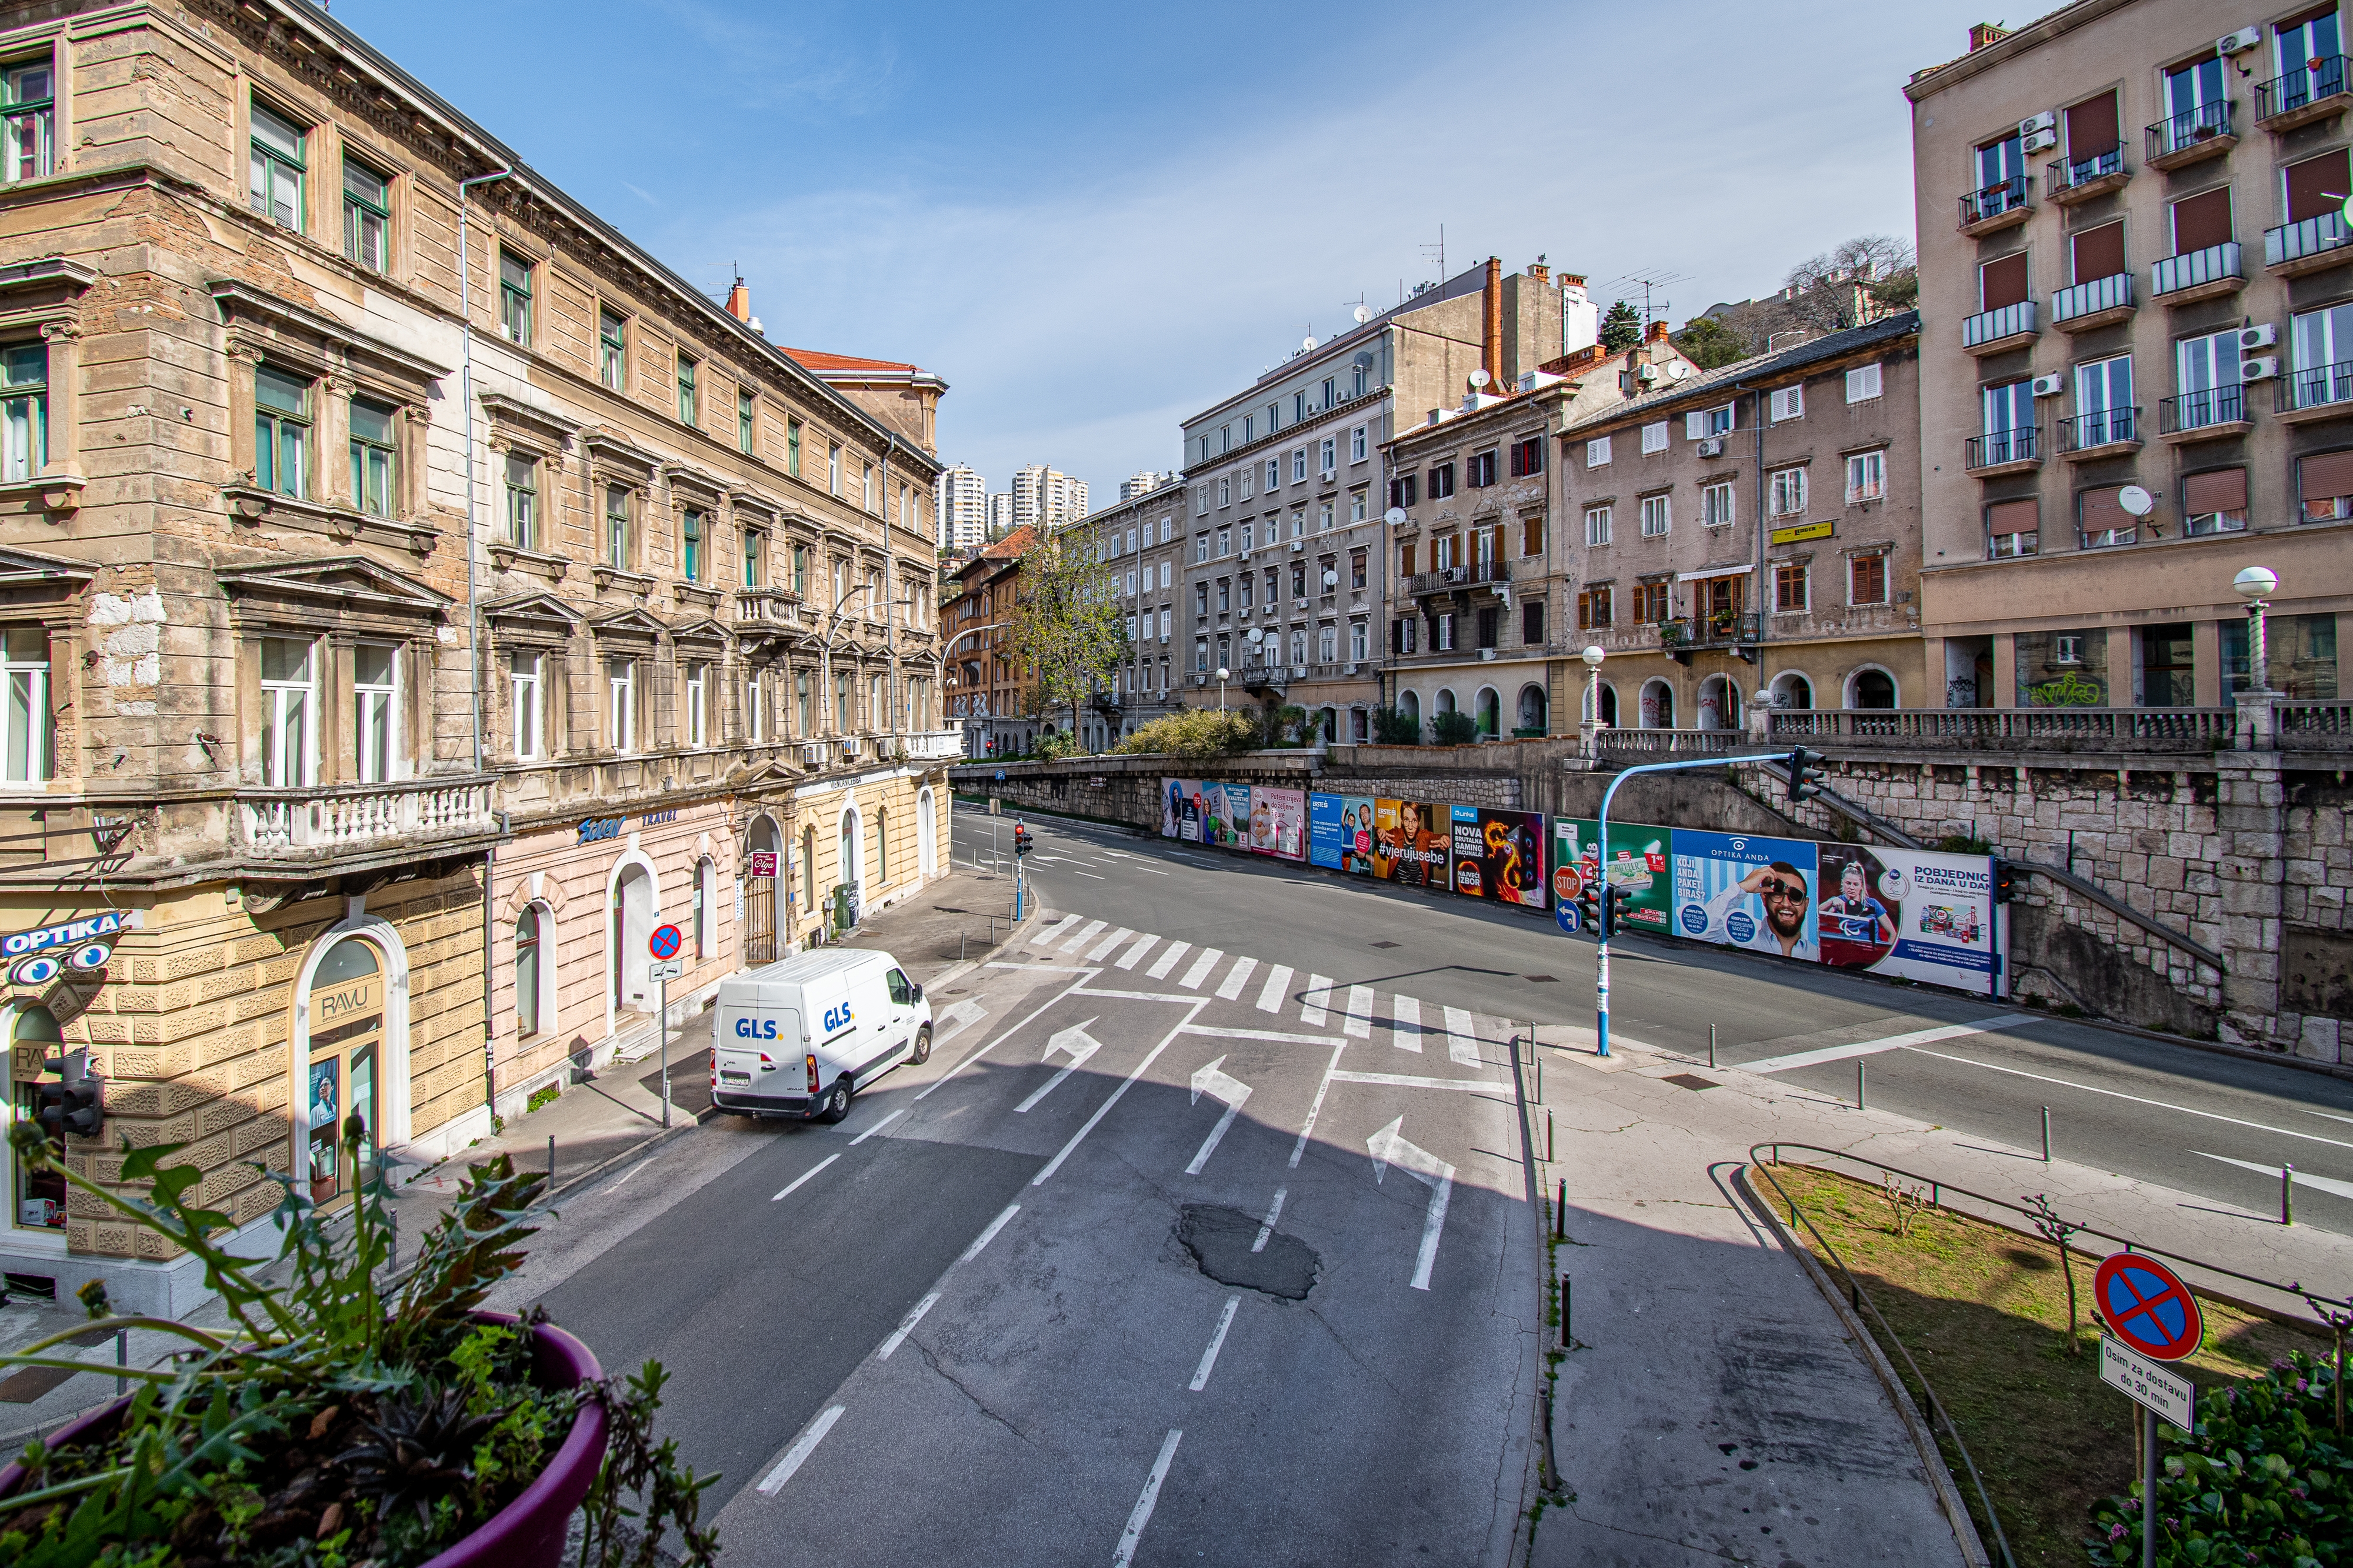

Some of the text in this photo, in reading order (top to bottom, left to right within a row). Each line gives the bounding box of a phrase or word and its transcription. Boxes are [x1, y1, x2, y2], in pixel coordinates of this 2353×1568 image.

[1794, 527, 1817, 536] LEADER
[1287, 795, 1301, 803] crijeva
[1278, 802, 1294, 811] željene
[1271, 809, 1285, 819] figure
[576, 809, 677, 847] SOLEN TRAVEL
[1455, 825, 1482, 838] NOVA
[1455, 836, 1483, 845] BRUTALNA
[1455, 842, 1483, 852] GAMING
[1379, 843, 1444, 864] #vjerujusebe
[1455, 849, 1483, 858] RAČUNALA!
[1711, 849, 1741, 859] OPTIKA
[754, 859, 775, 870] Olga
[1614, 862, 1640, 872] BUTTER
[1677, 858, 1695, 868] KOJI
[1458, 870, 1480, 879] NAJVEĆI
[1677, 869, 1698, 879] ANDA
[1458, 876, 1480, 886] IZBOR
[1557, 876, 1577, 890] STOP
[1677, 878, 1701, 889] PAKET
[1927, 877, 1956, 887] DANA
[1678, 888, 1705, 900] BIRAŠ?
[1629, 913, 1659, 922] INTERSPAR
[1683, 913, 1706, 921] DIOPTRIJSKE
[1727, 920, 1754, 929] PROGRESIVNE
[5, 916, 118, 953] OPTIKA
[322, 986, 367, 1017] RAVU
[340, 1005, 368, 1017] OPTOMETRIJA
[2105, 1346, 2187, 1402] Osim za dostavu
[2120, 1373, 2169, 1409] do 30 min
